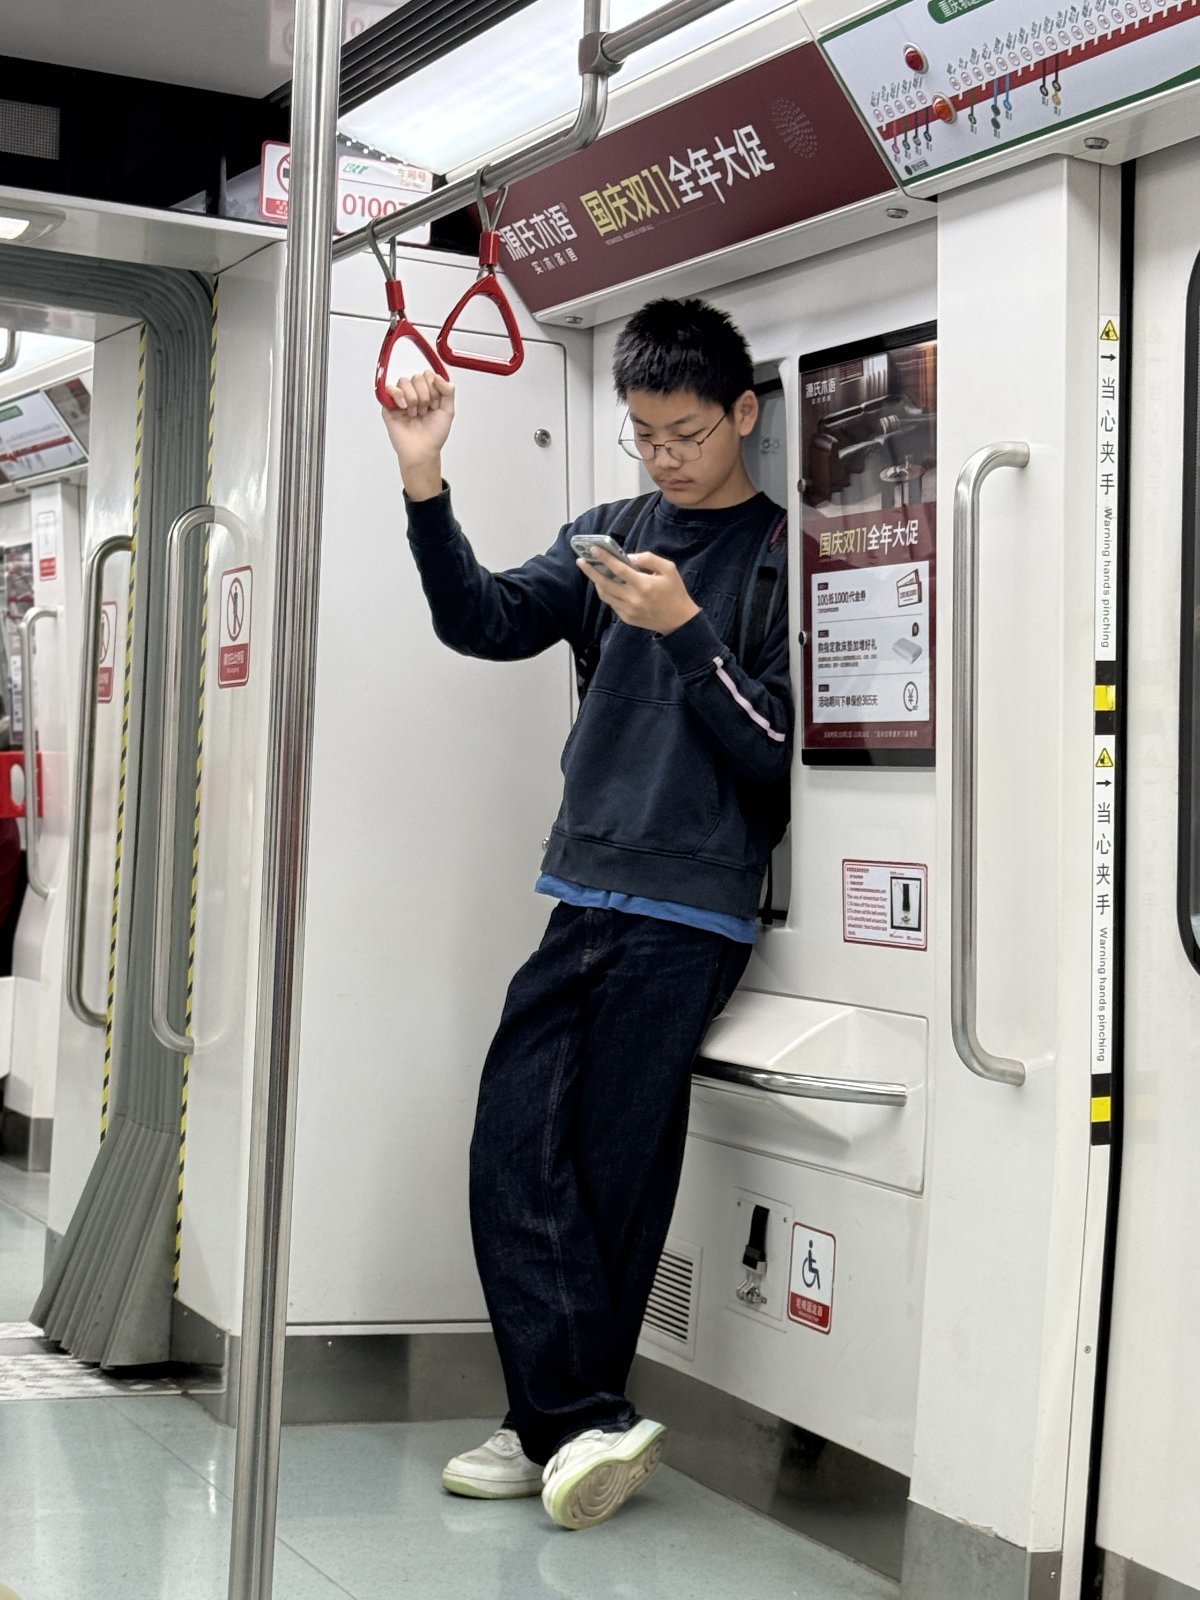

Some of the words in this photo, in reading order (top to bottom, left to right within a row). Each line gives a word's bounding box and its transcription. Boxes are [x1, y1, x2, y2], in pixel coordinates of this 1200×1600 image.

[579, 124, 776, 237] 国庆双11全年大促
[495, 204, 578, 262] 源氏木语
[1100, 377, 1116, 496] 当心夹手
[819, 519, 919, 556] 国庆双11全年大促
[1102, 506, 1113, 557] Warning
[1103, 560, 1112, 596] hands
[1101, 599, 1111, 648] pinching
[1096, 801, 1112, 915] 当心夹手
[1097, 926, 1108, 975] Warning
[1098, 977, 1107, 1012] hands
[1096, 1014, 1107, 1062] pinching
